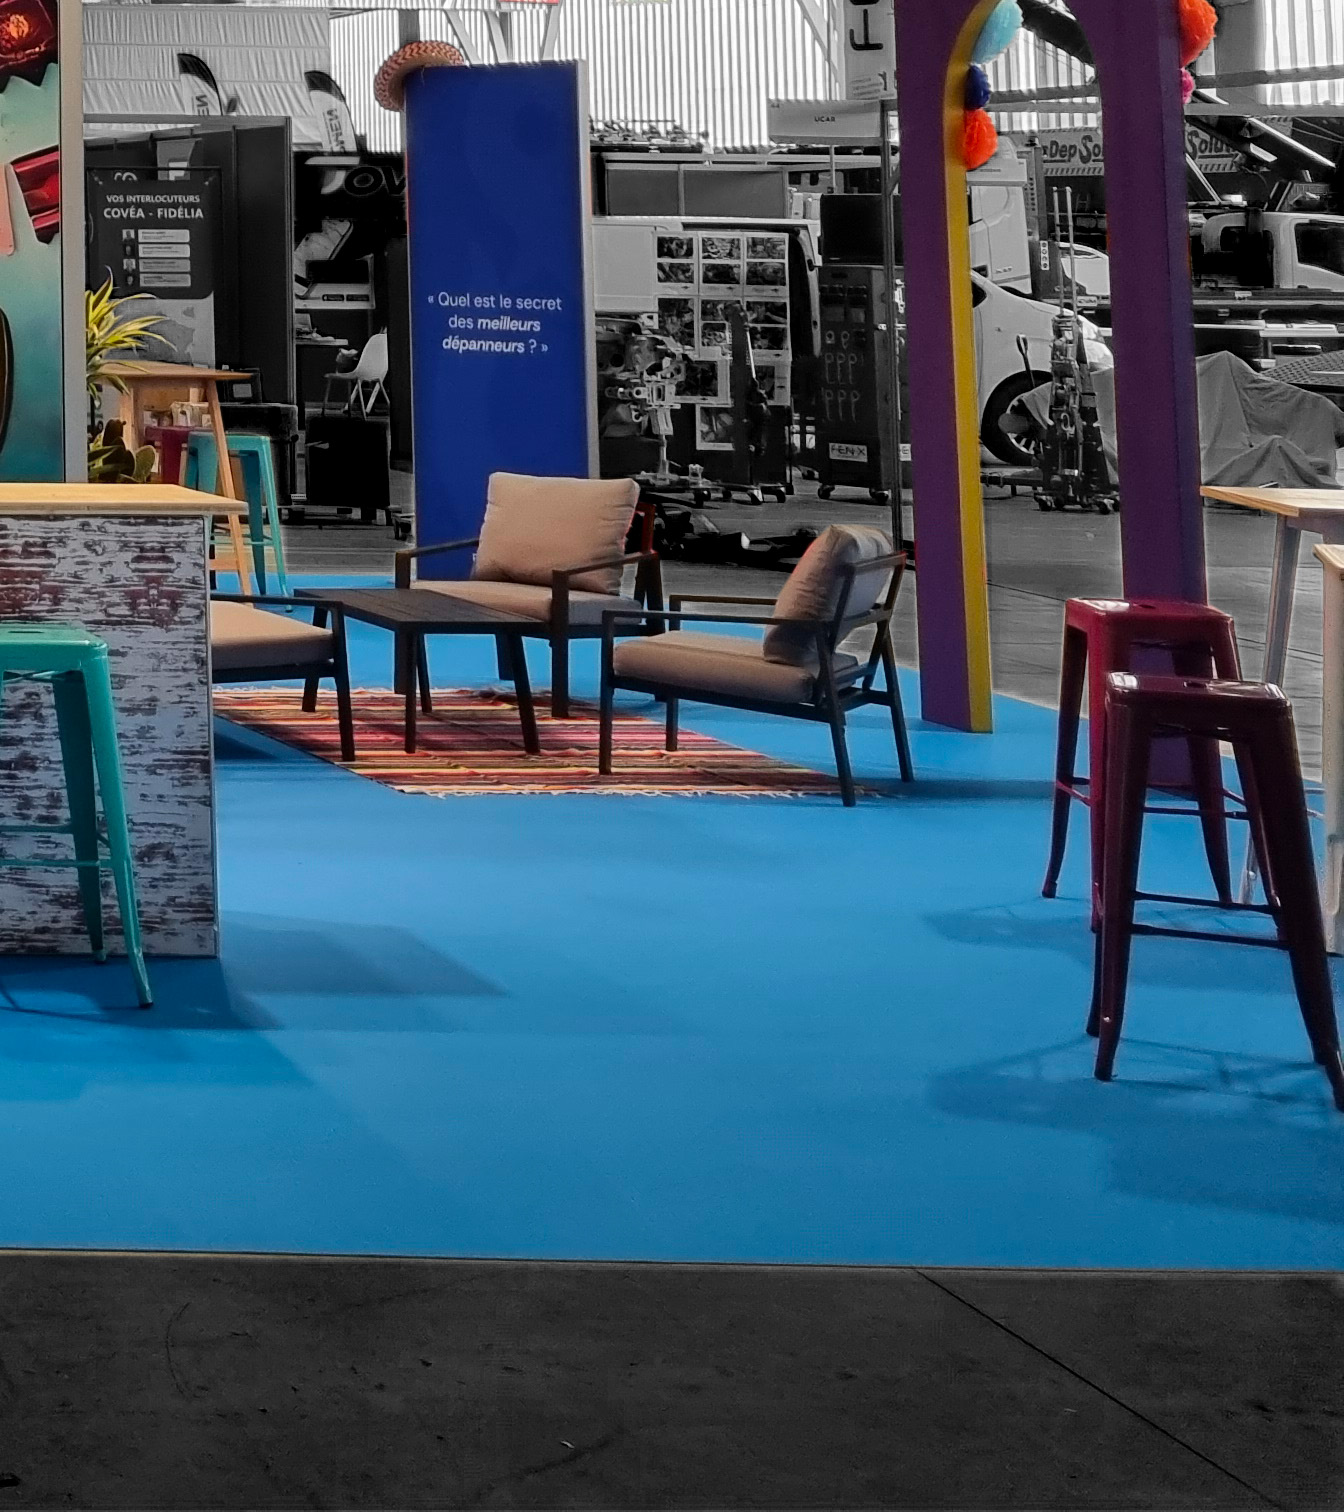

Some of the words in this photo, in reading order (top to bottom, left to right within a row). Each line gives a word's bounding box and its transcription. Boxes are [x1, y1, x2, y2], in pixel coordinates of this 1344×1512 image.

[106, 194, 124, 203] VOS
[126, 194, 200, 203] INTERLOCUTEURS
[103, 205, 146, 219] COVÉA
[157, 205, 204, 219] FIDÉLIA
[438, 292, 470, 307] Quel
[474, 295, 496, 308] est
[500, 294, 512, 308] le
[516, 297, 562, 311] secret
[448, 314, 474, 328] des
[477, 315, 541, 331] meilleurs
[442, 335, 525, 354] dépanneurs
